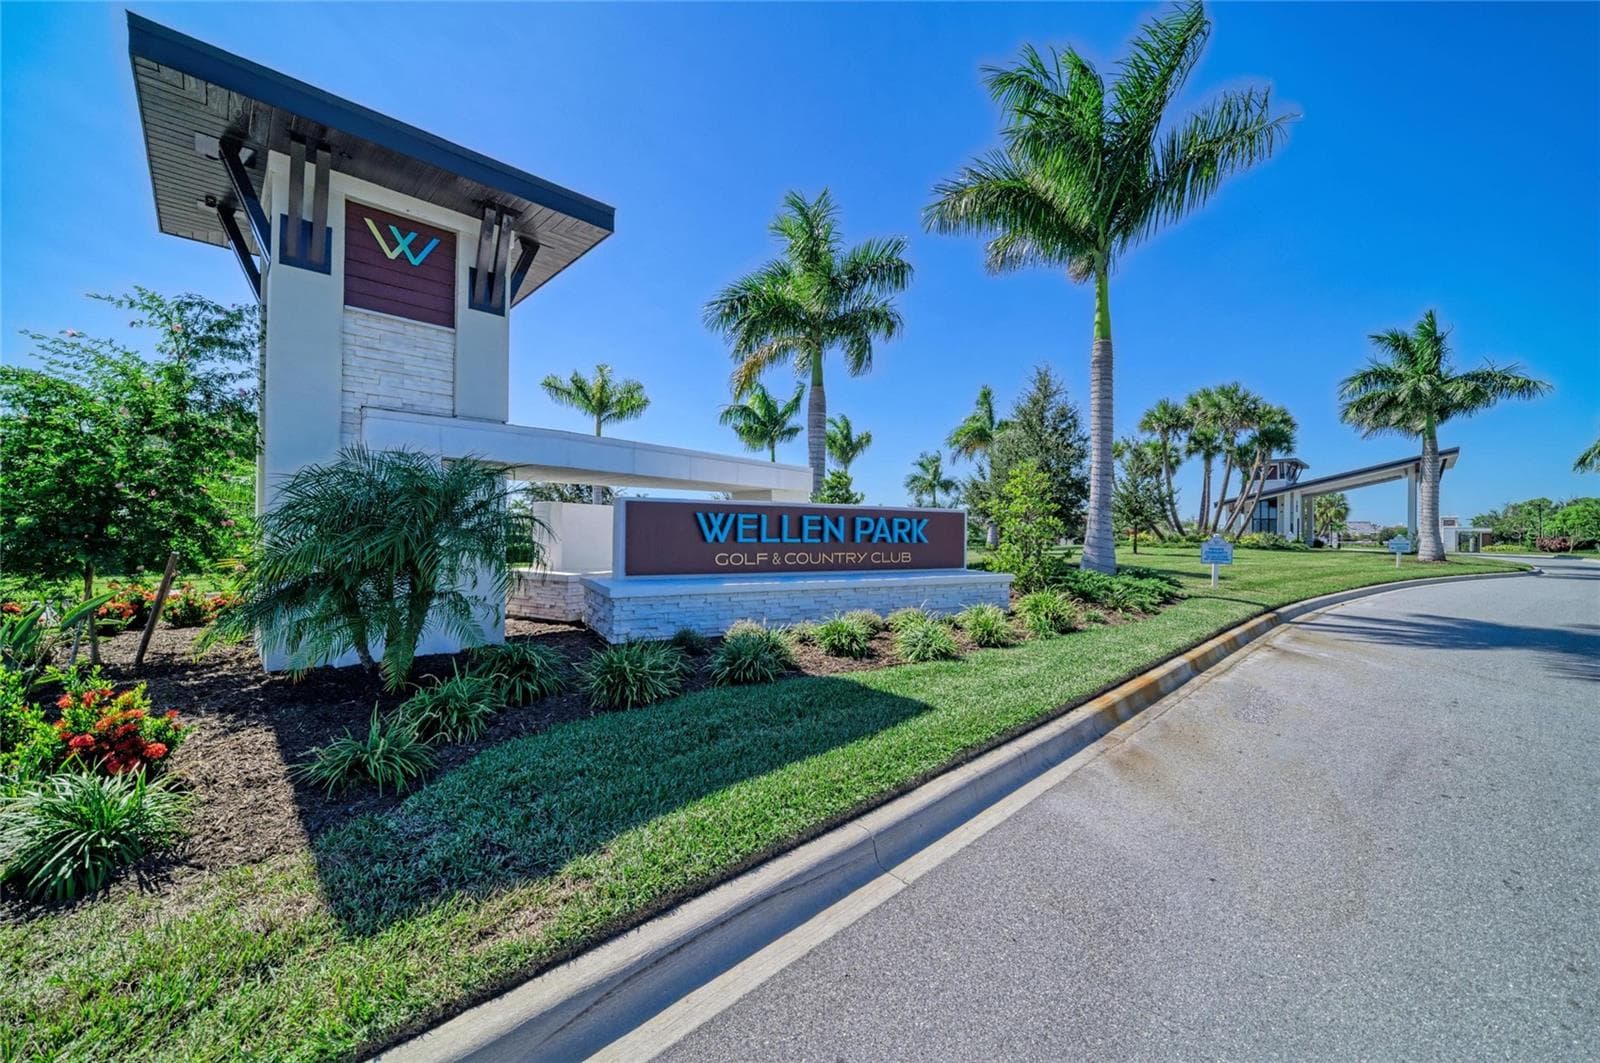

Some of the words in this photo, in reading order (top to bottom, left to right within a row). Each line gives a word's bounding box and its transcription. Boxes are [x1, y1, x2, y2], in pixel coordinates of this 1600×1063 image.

[695, 511, 845, 544] WELLEN
[854, 516, 930, 544] PARK
[714, 552, 769, 566] GOLF
[772, 552, 782, 566] &
[784, 552, 868, 565] COUNTRY
[870, 551, 912, 564] CLUB
